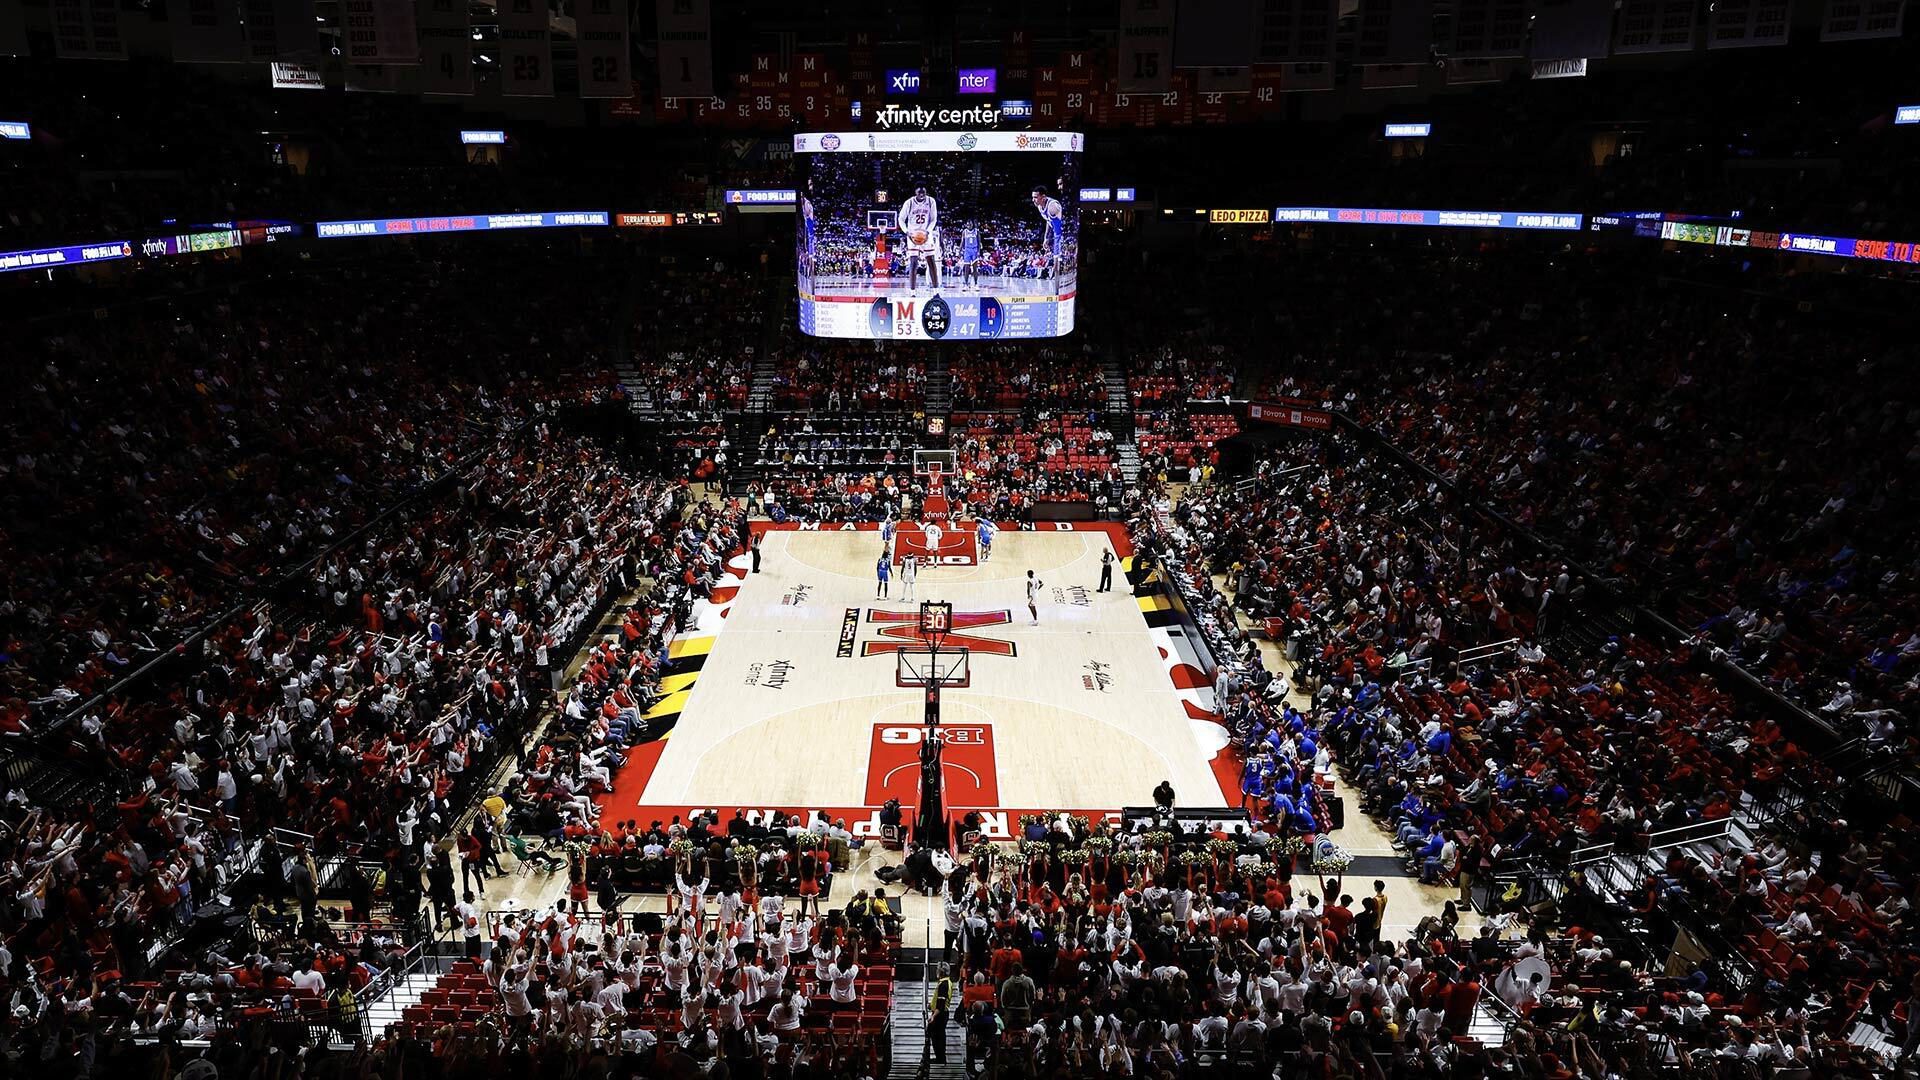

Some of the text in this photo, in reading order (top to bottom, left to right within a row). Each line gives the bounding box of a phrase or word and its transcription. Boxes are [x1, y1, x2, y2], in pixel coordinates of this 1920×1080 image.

[513, 56, 540, 80] 23
[592, 56, 618, 82] 22
[680, 57, 692, 82] 1
[758, 57, 768, 70] M
[804, 57, 814, 70] M
[1134, 53, 1159, 78] 15
[1067, 93, 1082, 108] 23
[1257, 87, 1273, 102] 42
[756, 96, 772, 110] 35
[806, 96, 814, 110] 3
[778, 104, 790, 117] 55
[876, 104, 1001, 128] xfinity center
[1040, 103, 1053, 117] 41
[768, 143, 790, 152] BUD
[916, 214, 926, 224] 25
[1212, 212, 1268, 222] LEDO PIZZA
[142, 238, 167, 256] xfinity
[1856, 240, 1888, 258] SCORE
[1892, 242, 1908, 260] TO
[896, 302, 914, 320] M
[988, 308, 996, 318] 18
[897, 324, 912, 336] 53
[928, 321, 945, 330] 9:54
[960, 324, 976, 336] 47
[1263, 410, 1286, 418] TOYOTA
[1303, 416, 1327, 424] TOYOTA
[924, 511, 948, 520] xfinity
[925, 614, 945, 629] 30
[1252, 764, 1258, 773] 3
